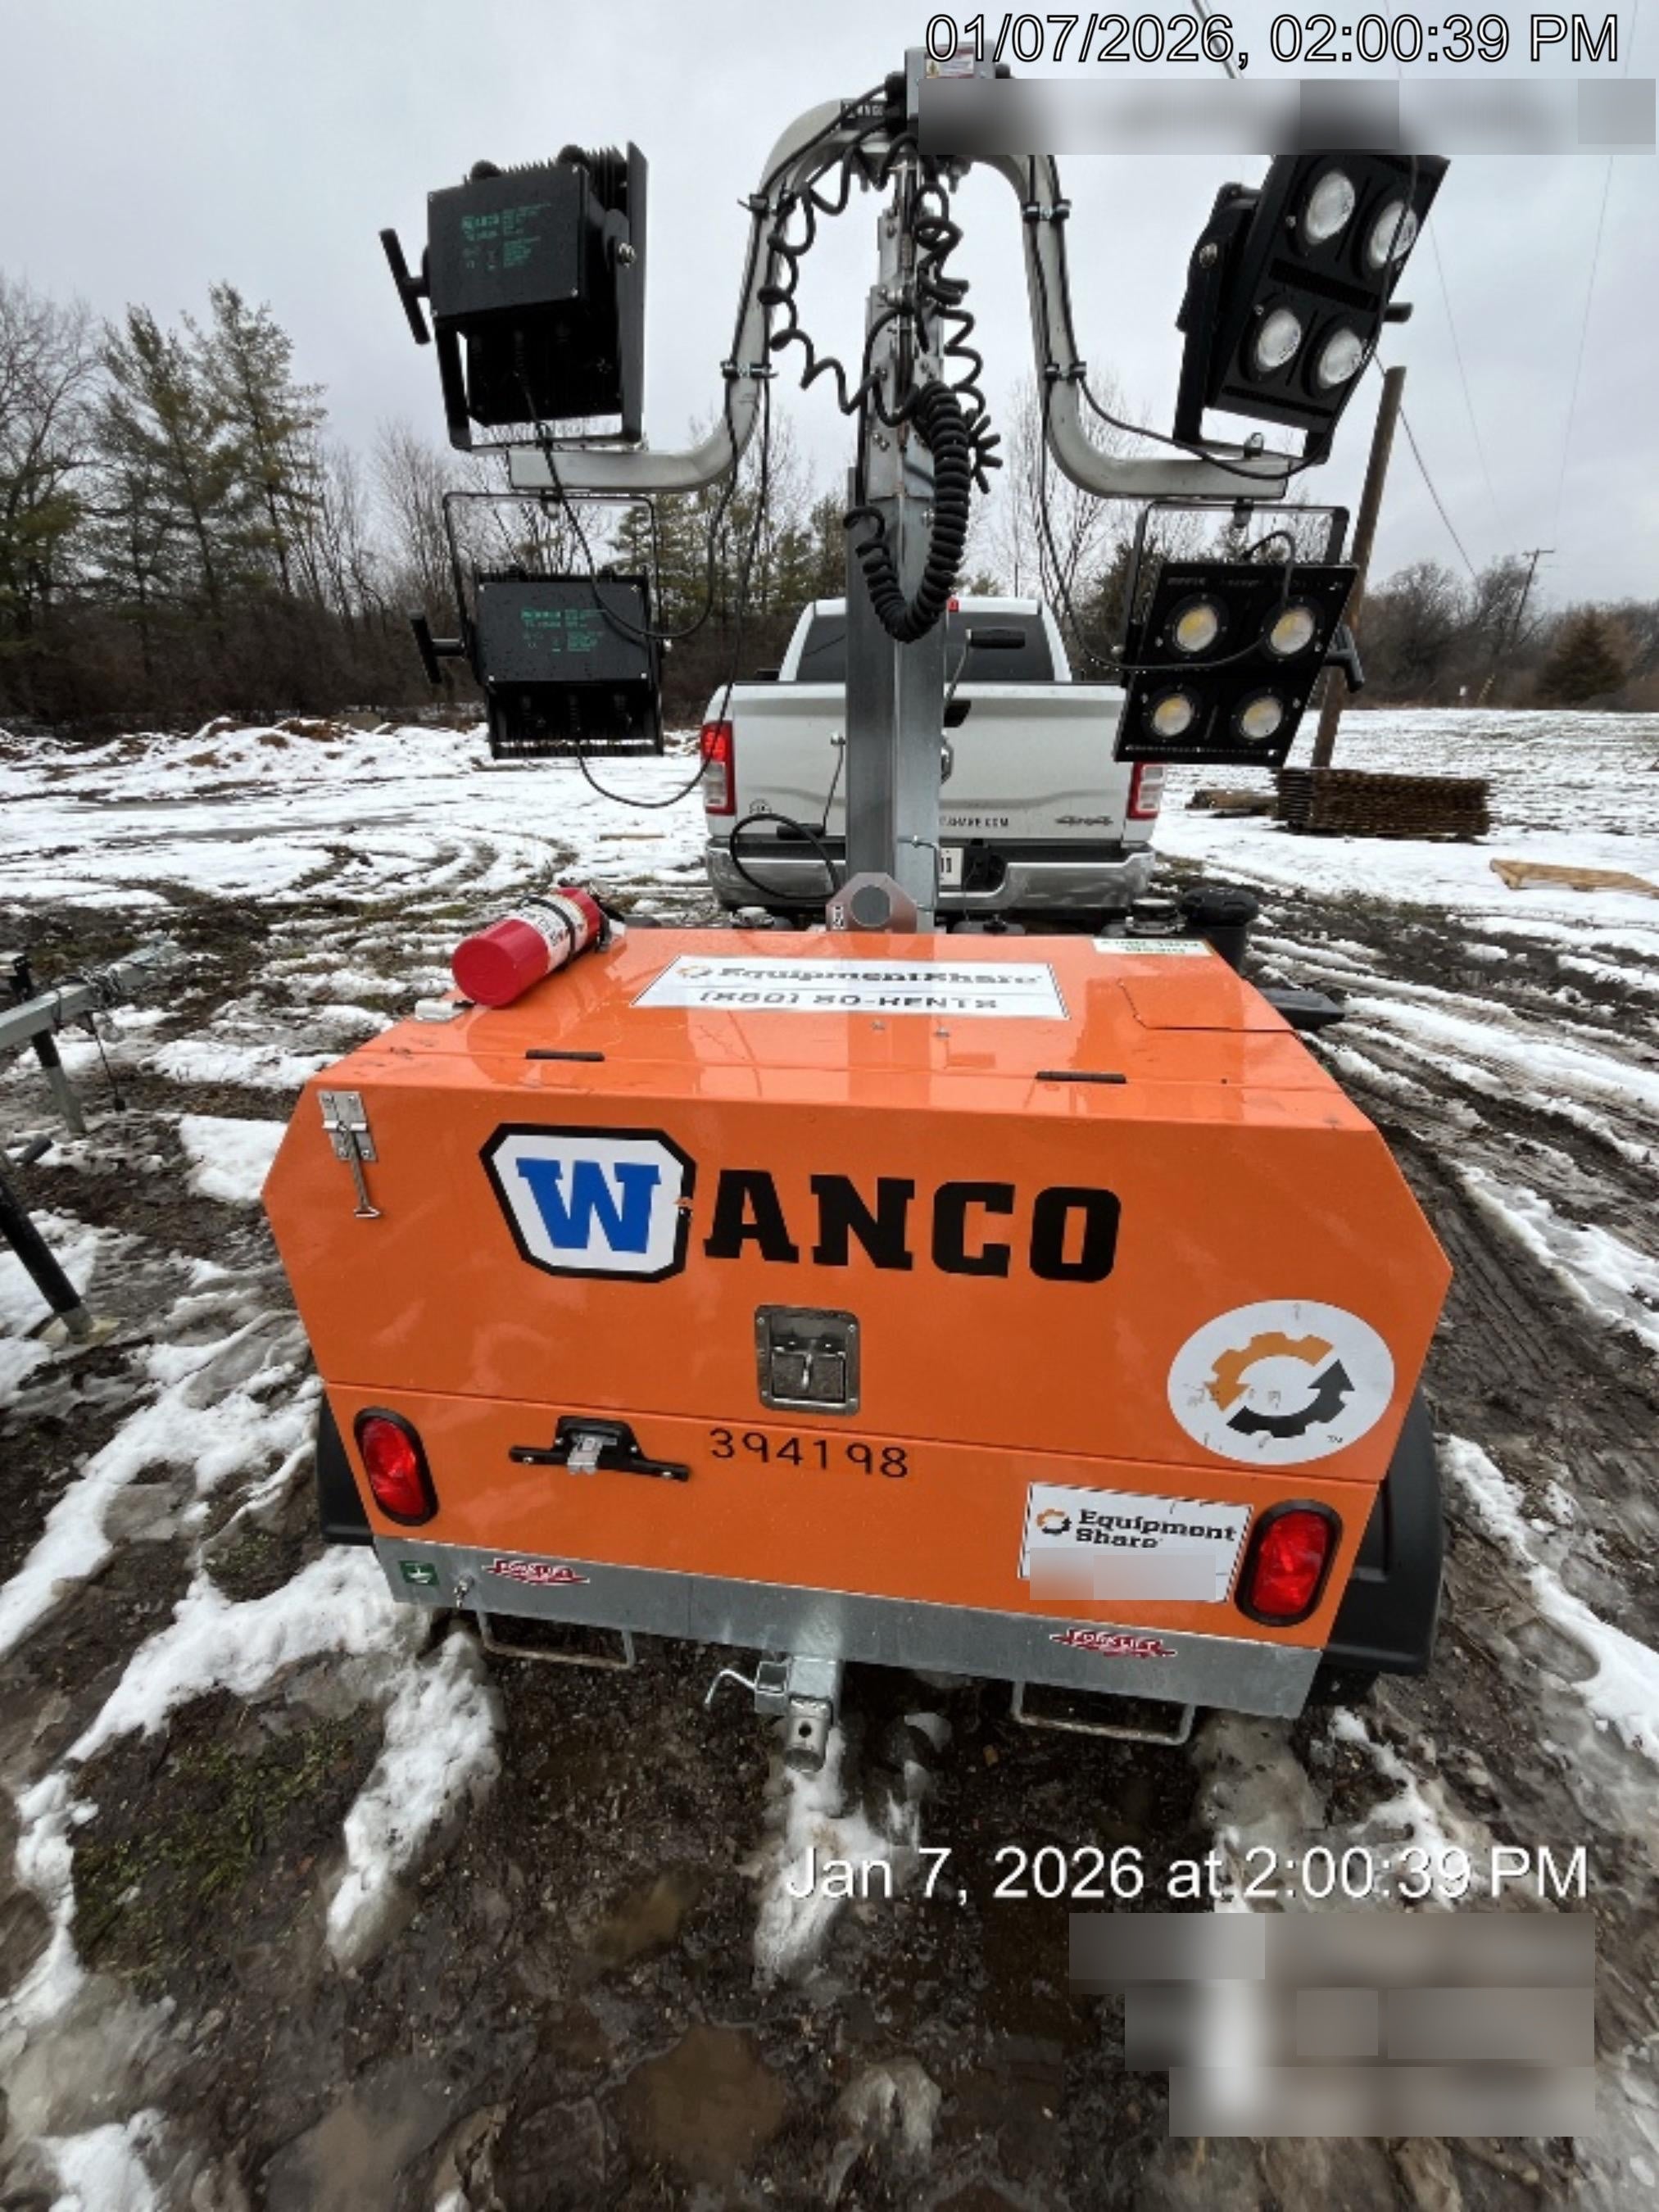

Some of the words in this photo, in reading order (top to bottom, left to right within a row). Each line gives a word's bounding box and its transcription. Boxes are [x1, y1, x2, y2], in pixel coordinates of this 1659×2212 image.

[515, 1156, 1122, 1284] WANCO
[709, 1427, 909, 1479] 394198
[1075, 1527, 1158, 1548] Share
[1078, 1509, 1236, 1542] Equipment
